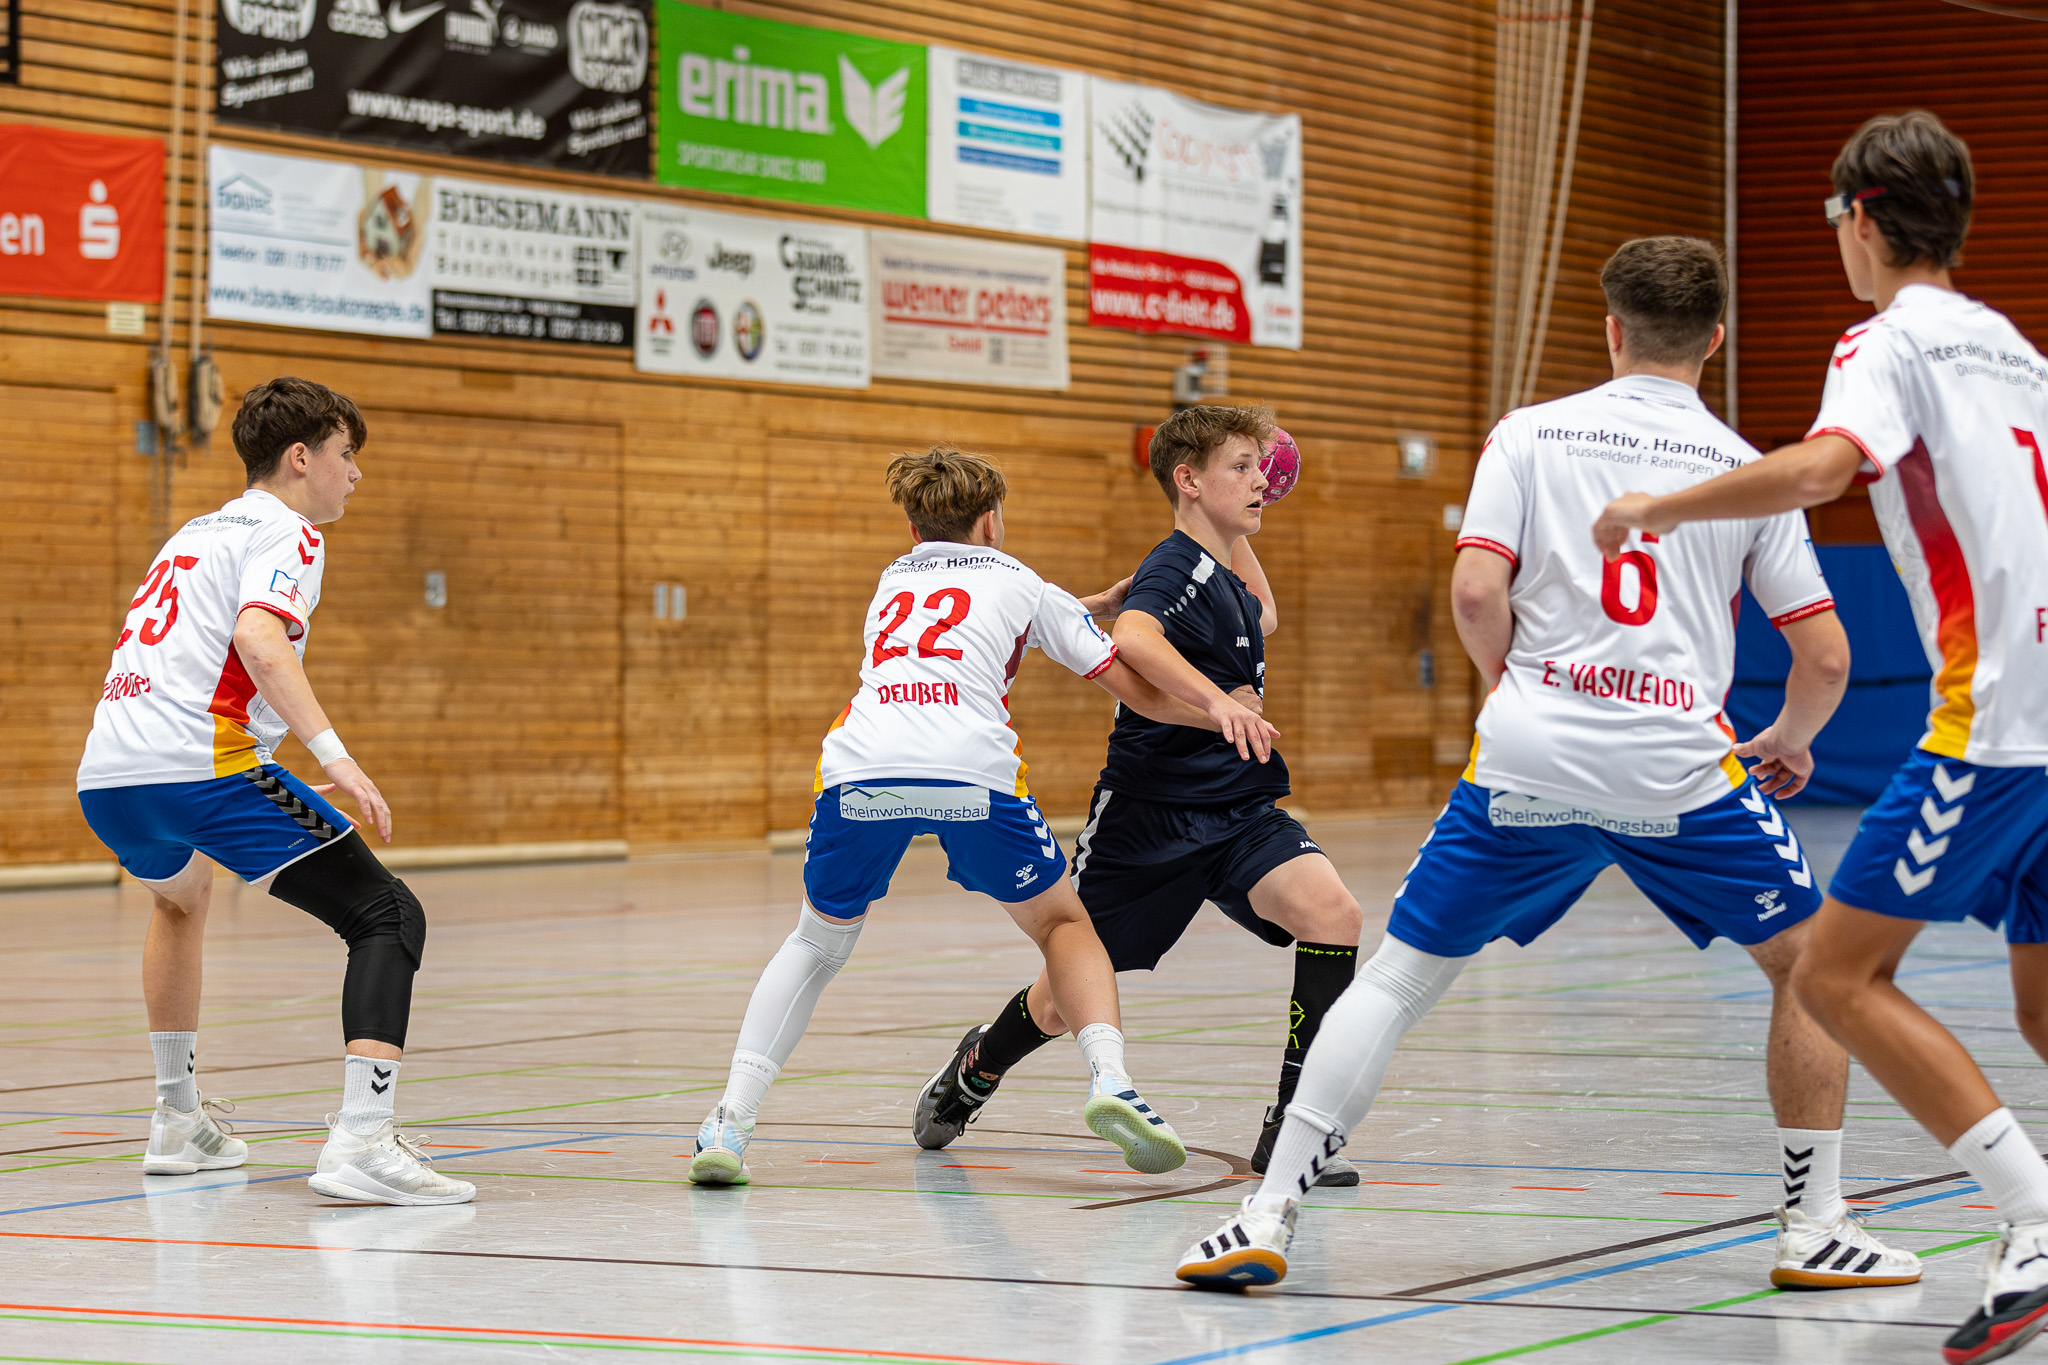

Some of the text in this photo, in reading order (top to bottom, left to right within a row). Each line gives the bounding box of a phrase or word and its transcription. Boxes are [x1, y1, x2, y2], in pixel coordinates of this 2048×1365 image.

[677, 44, 832, 136] erima
[439, 190, 630, 241] BIESEMANN
[707, 241, 756, 279] Jeep
[1653, 438, 1749, 469] Handbal
[115, 555, 200, 650] 25
[1601, 529, 1660, 626] 6
[872, 587, 971, 669] 22
[1542, 660, 1694, 711] E. VASILEIOU
[841, 802, 989, 820] Rheinwohnungsbau
